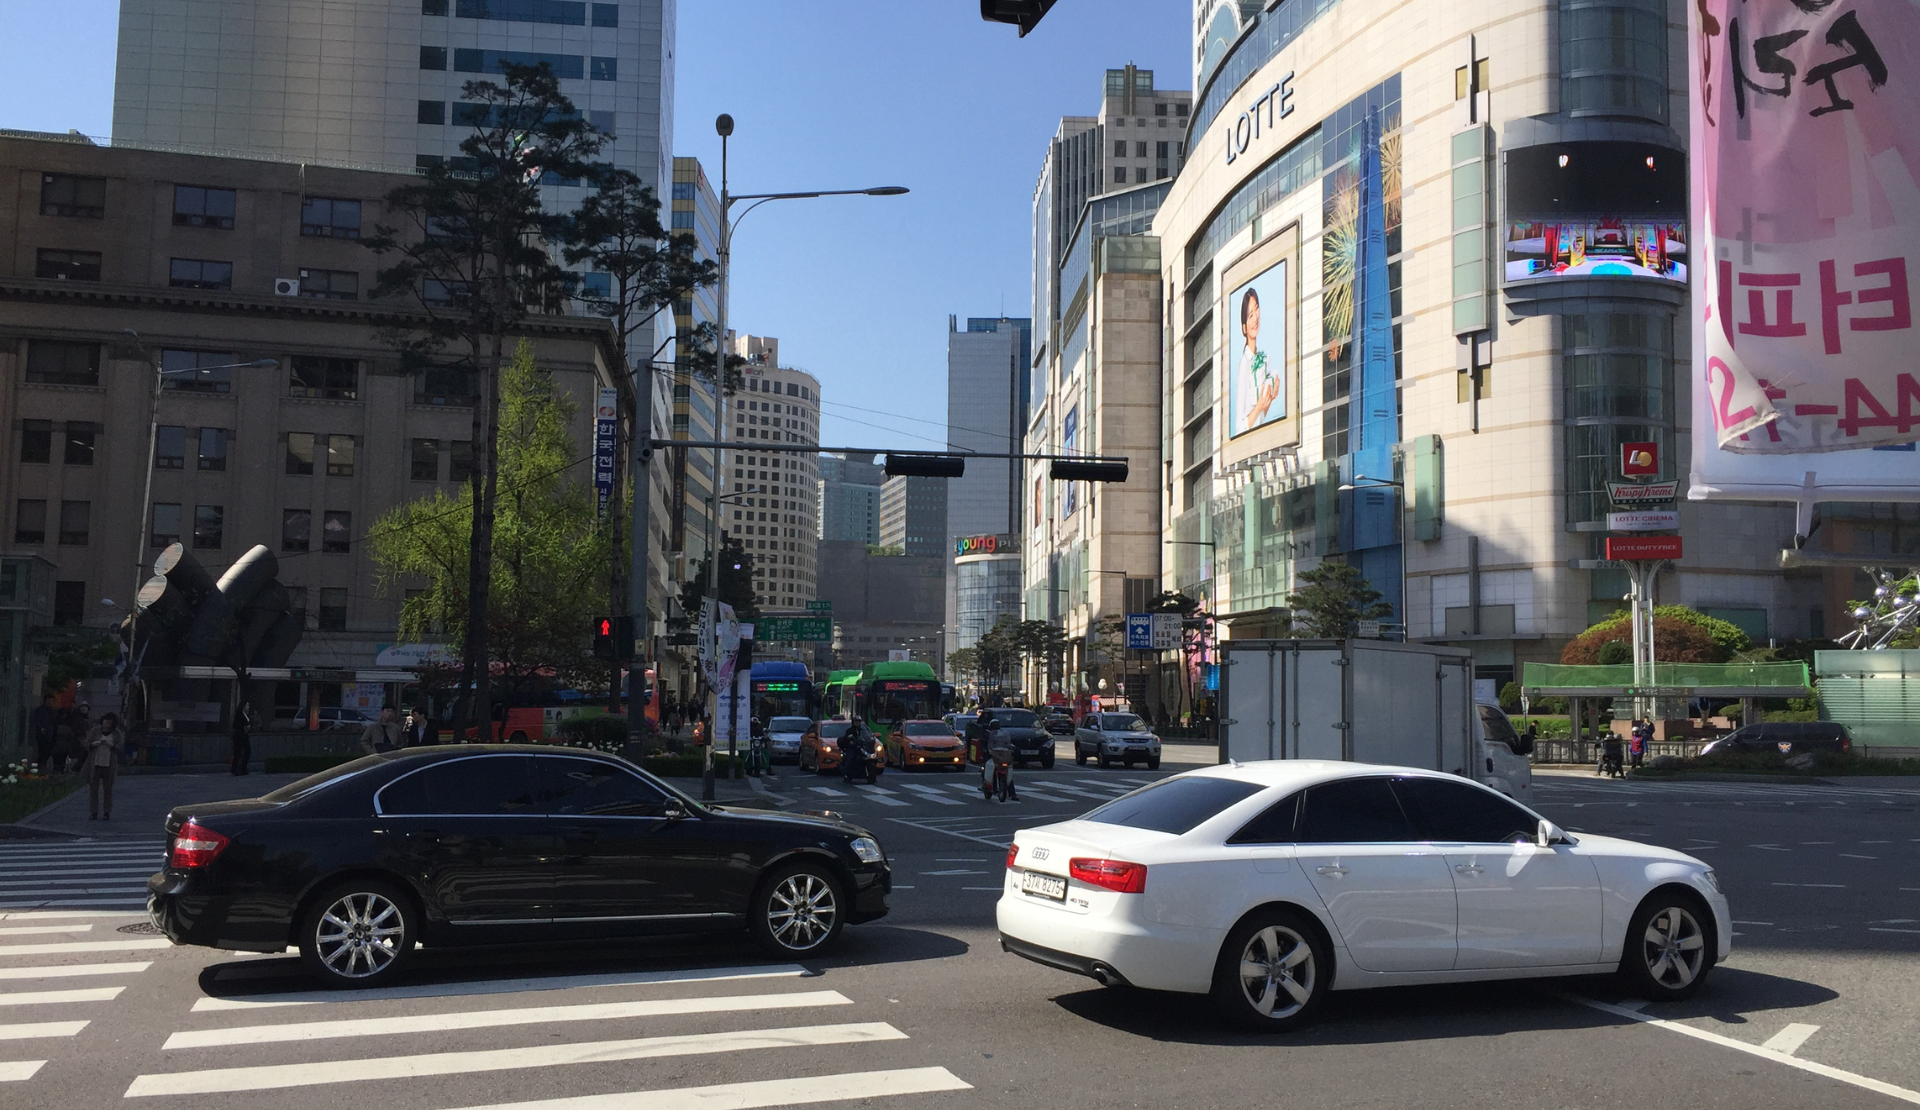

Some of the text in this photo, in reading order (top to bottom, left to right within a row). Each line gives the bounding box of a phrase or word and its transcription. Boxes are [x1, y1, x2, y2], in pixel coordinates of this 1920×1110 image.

[1226, 70, 1295, 165] LOTTE
[598, 422, 615, 485] 한국전력
[1614, 484, 1674, 499] Krispy Kreme
[957, 535, 997, 556] young
[1164, 622, 1182, 630] 21:00
[1042, 877, 1060, 895] 8275
